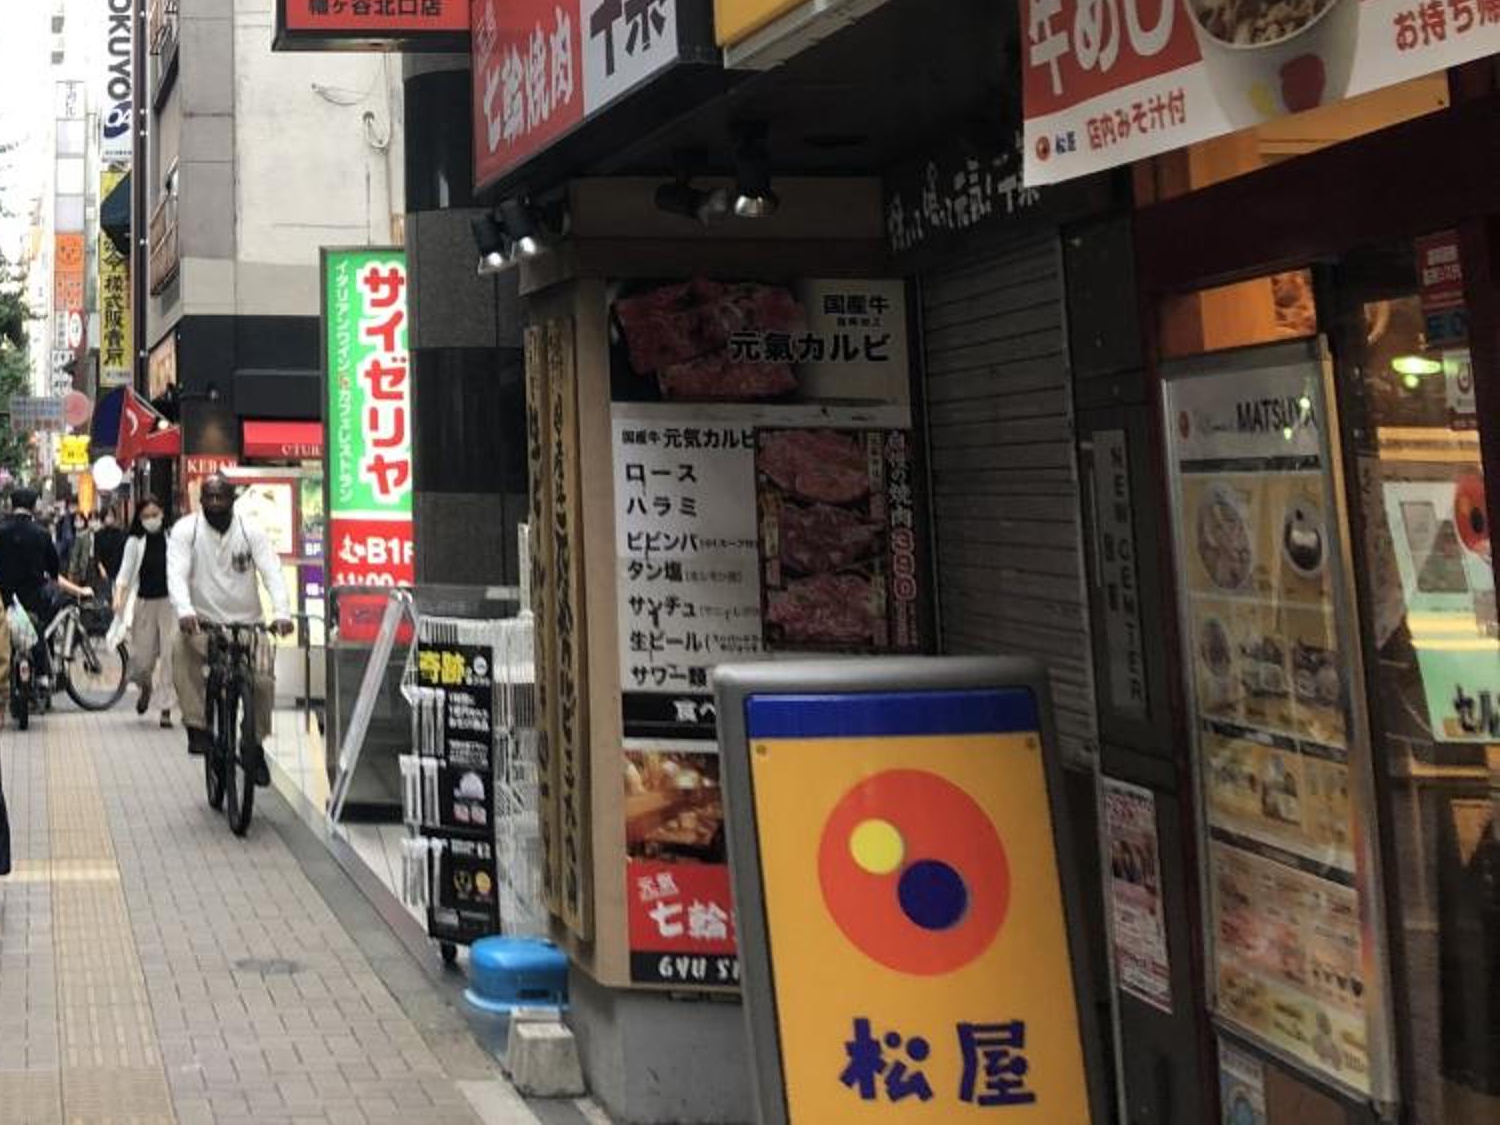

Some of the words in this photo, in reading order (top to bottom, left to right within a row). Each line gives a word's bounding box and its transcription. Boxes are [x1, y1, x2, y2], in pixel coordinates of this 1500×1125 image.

[1086, 87, 1187, 150] 店内みそ汁付
[362, 263, 412, 499] サイゼリヤ
[625, 463, 698, 483] ロース
[626, 496, 698, 518] ハラミ
[626, 530, 698, 553] ビビンバ
[648, 898, 738, 941] 七輪
[657, 955, 708, 980] GYU
[838, 1017, 1037, 1107] 松屋
